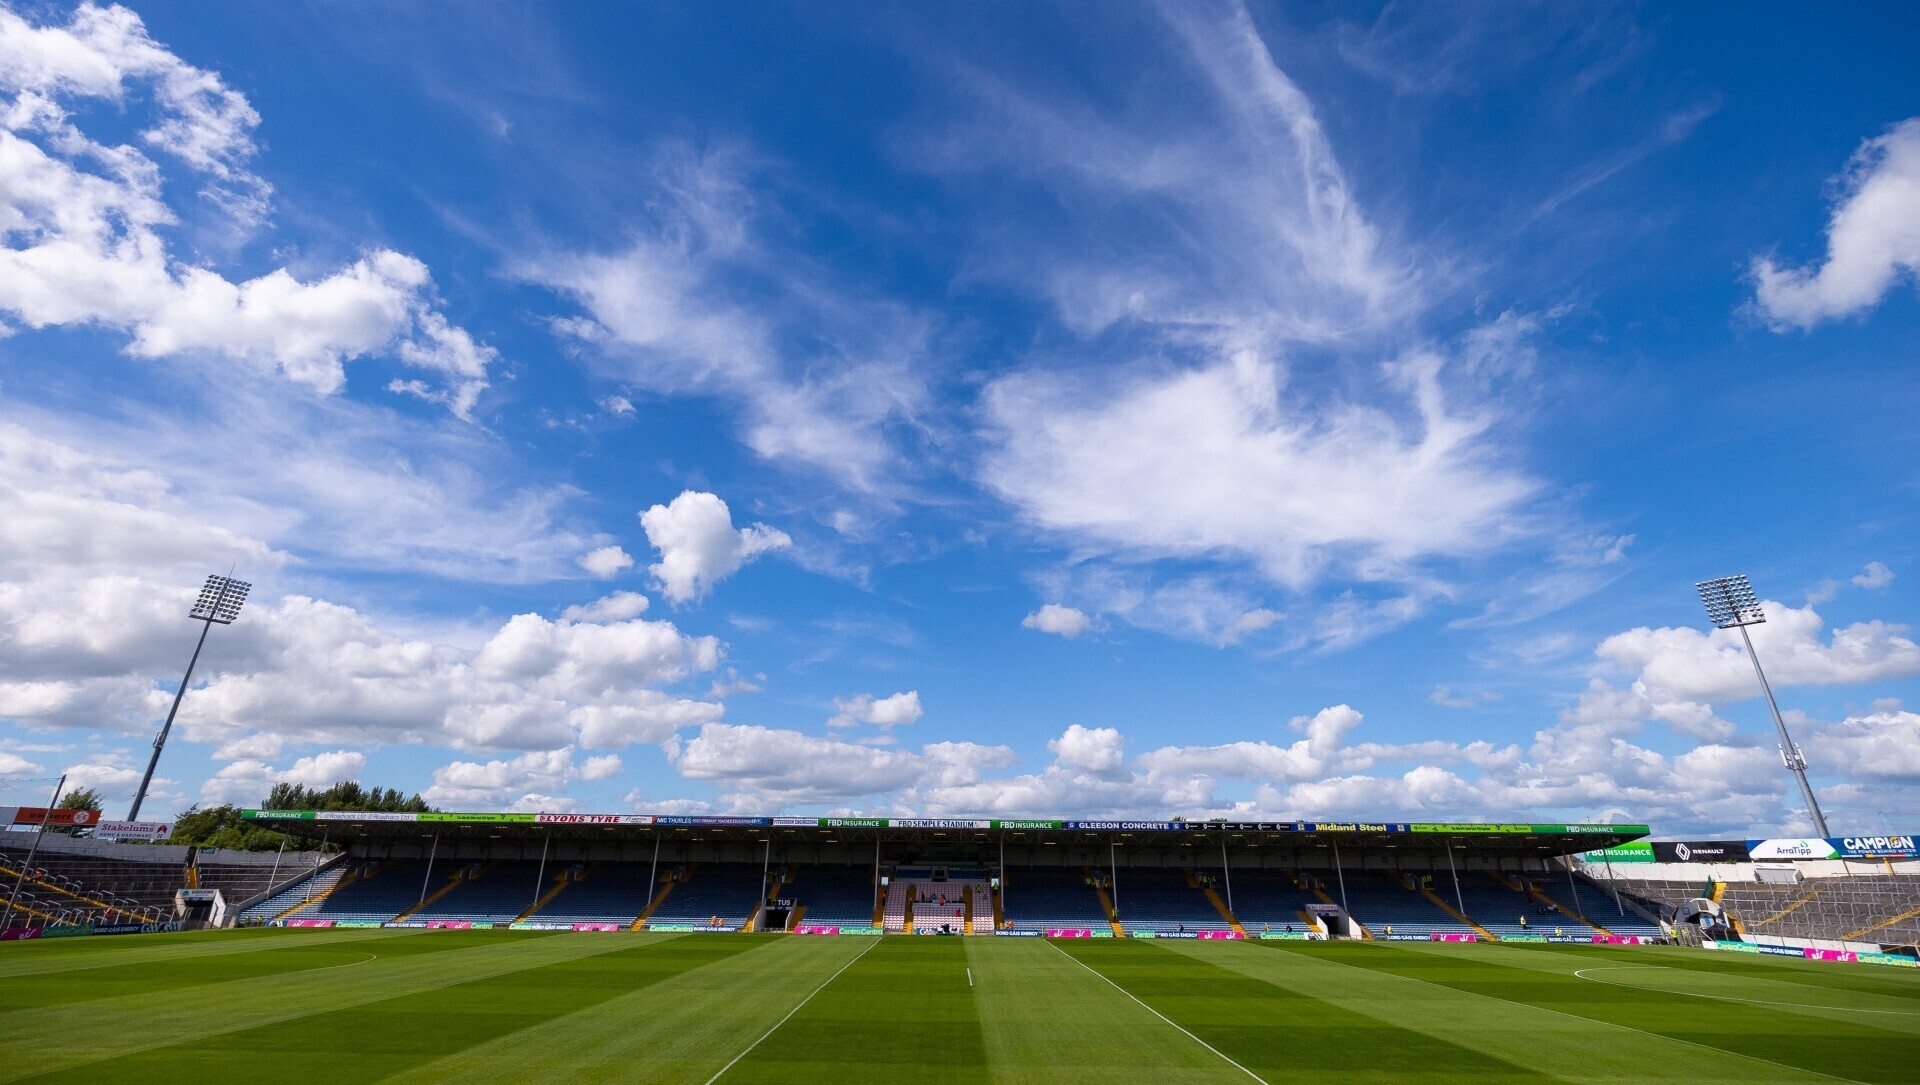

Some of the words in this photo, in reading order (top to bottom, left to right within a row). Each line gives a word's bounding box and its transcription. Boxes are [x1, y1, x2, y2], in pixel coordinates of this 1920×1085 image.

[101, 823, 154, 832] Stakelums
[898, 820, 912, 828] FBD
[913, 820, 941, 828] SEMPLE
[1000, 821, 1015, 829] FBD
[1843, 836, 1915, 850] CAMPION
[1776, 846, 1811, 855] ArraTipp
